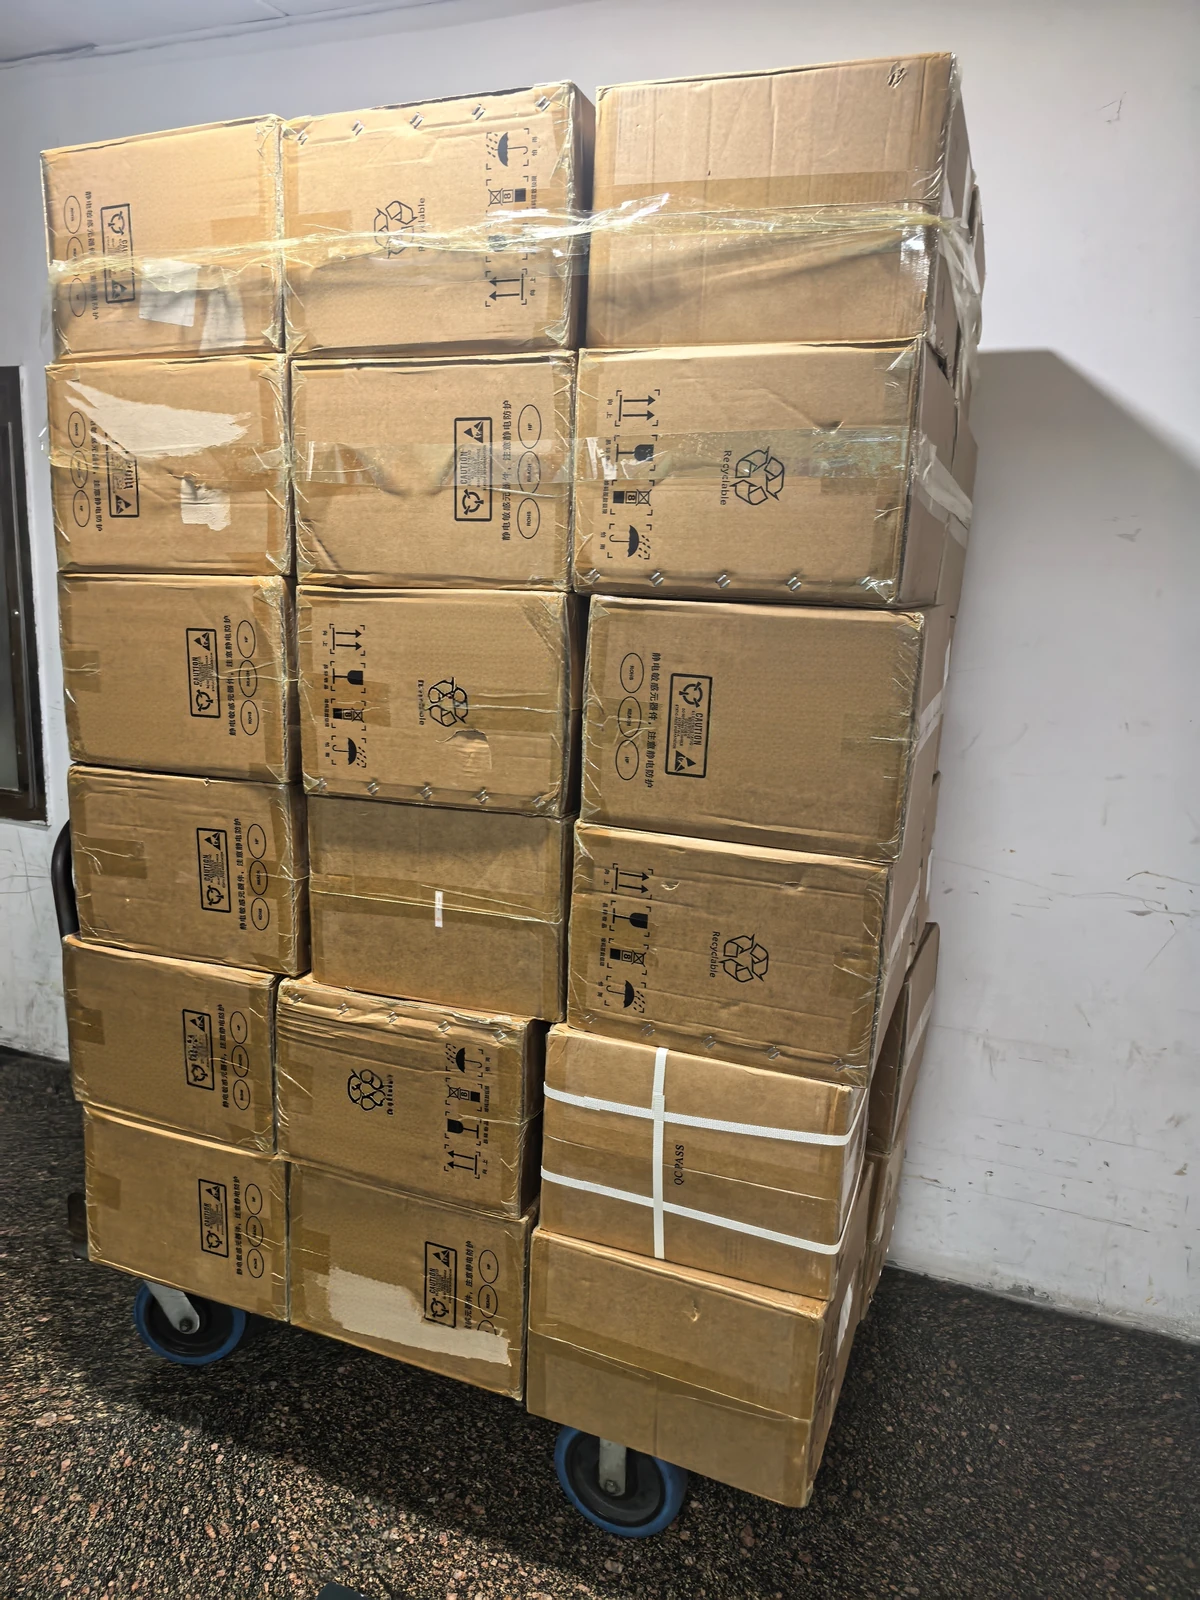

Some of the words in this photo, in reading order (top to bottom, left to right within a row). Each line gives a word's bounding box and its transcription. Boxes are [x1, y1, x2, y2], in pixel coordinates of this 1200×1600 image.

[460, 451, 468, 484] CAUTION
[720, 450, 732, 505] Recyclable
[192, 656, 200, 686] CAUTION
[694, 713, 703, 745] CAUTION
[709, 931, 720, 978] Recyclable
[674, 1144, 685, 1169] PASS
[674, 1171, 685, 1186] QC
